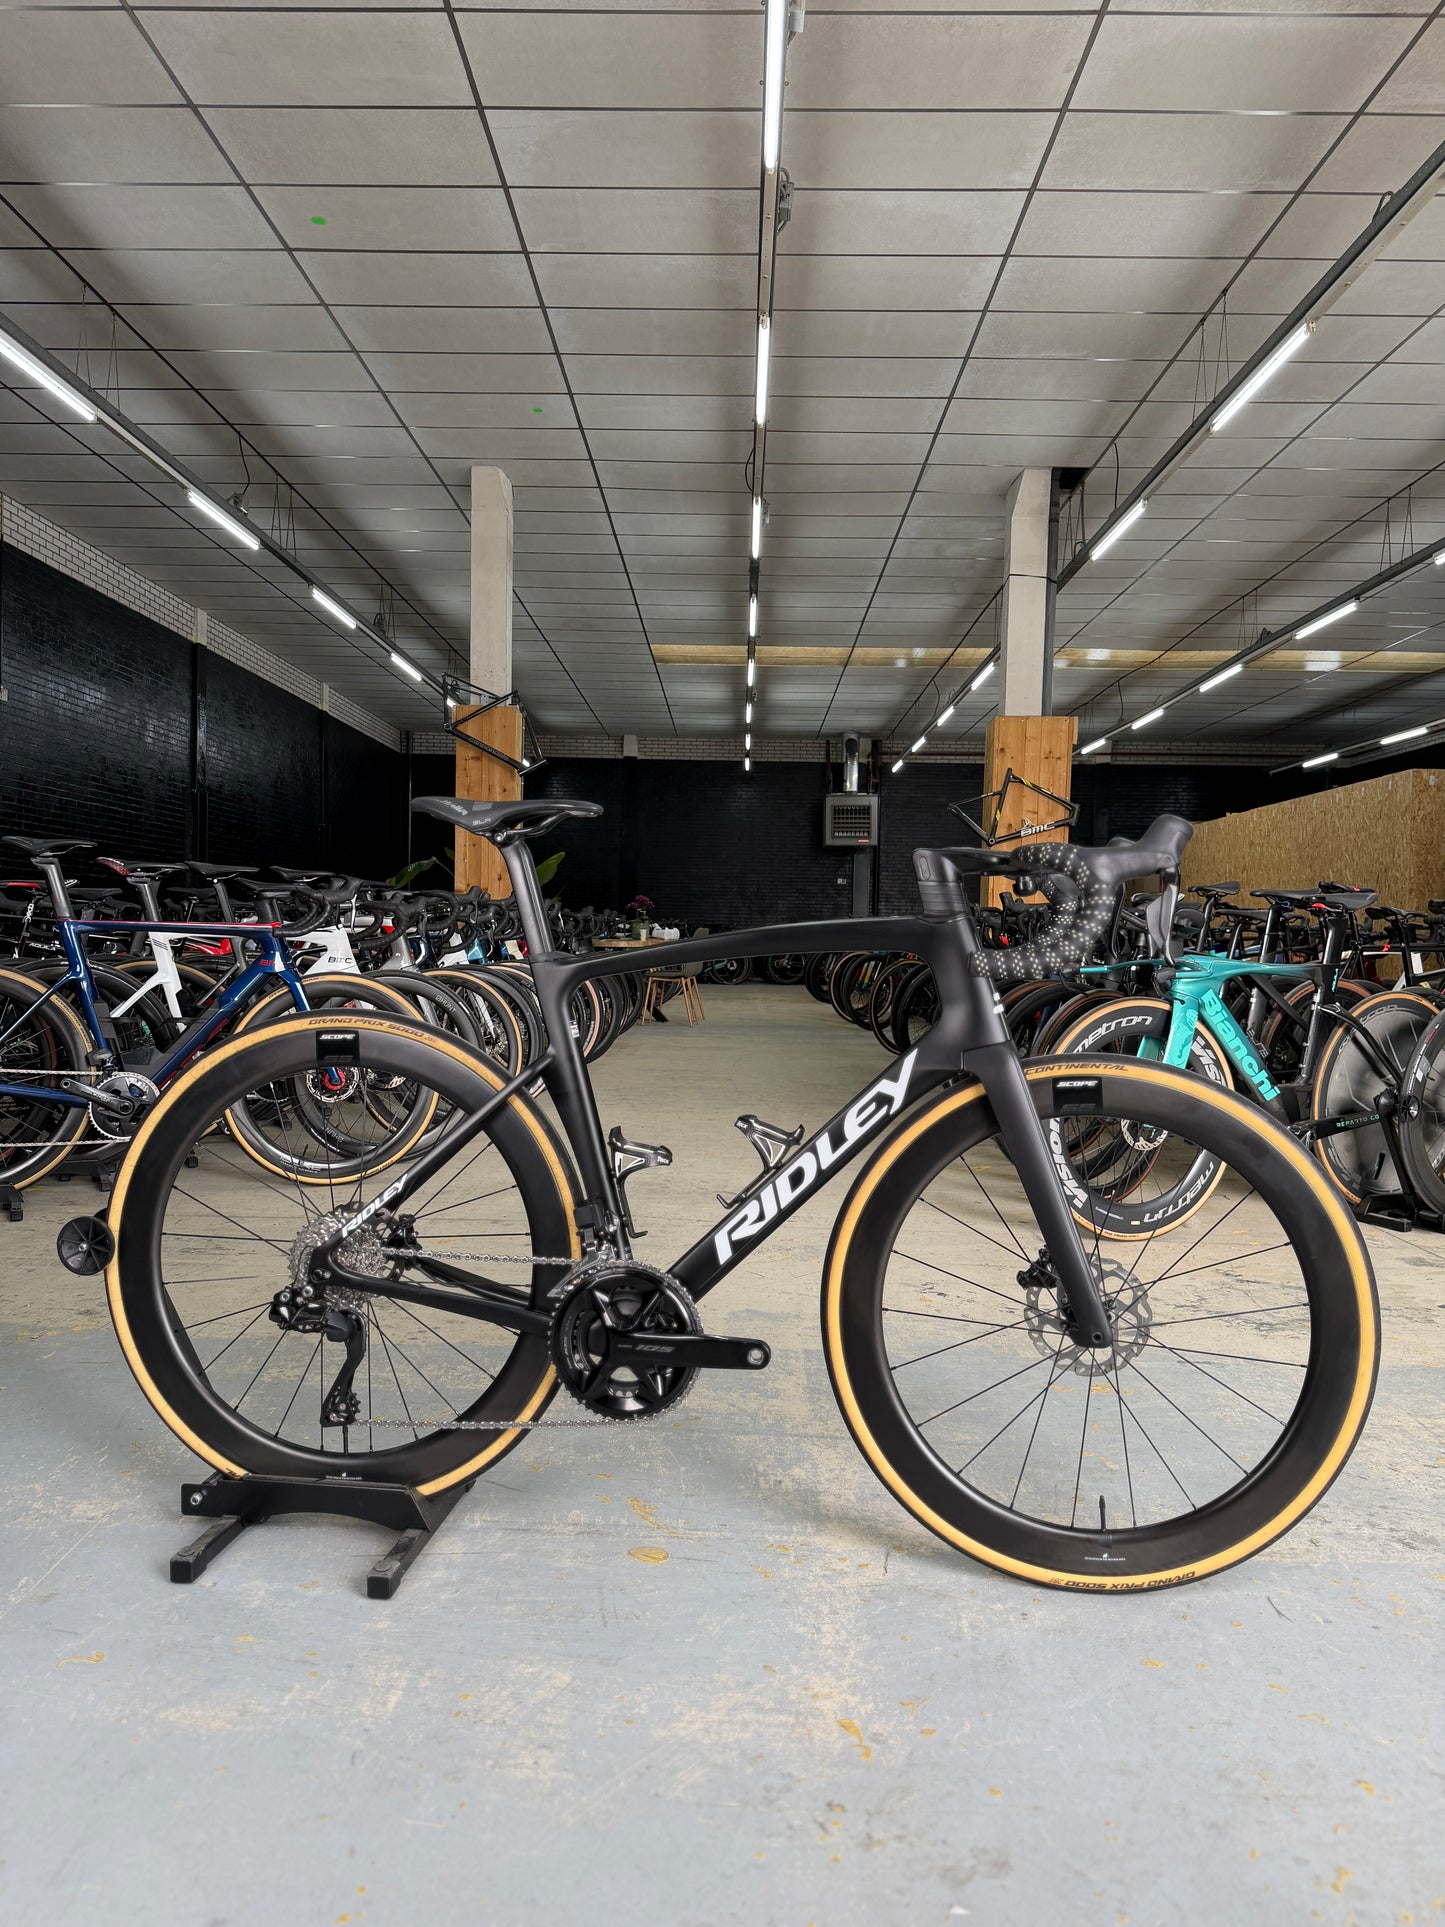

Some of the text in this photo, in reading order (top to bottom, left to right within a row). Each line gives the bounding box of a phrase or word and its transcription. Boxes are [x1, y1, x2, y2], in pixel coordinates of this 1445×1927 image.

[440, 996, 457, 1015] HUNT
[308, 1017, 425, 1038] GRAND PRIX 5000
[1201, 988, 1281, 1101] Bianchi
[1025, 1063, 1129, 1076] CONTINENTAL
[1056, 1080, 1099, 1088] SCOPE
[713, 1047, 919, 1266] RIDLEY
[341, 1173, 408, 1239] RIDLEY
[1063, 1579, 1108, 1590] 5000
[1107, 1580, 1146, 1590] PRIX
[1147, 1570, 1196, 1588] GRAND
